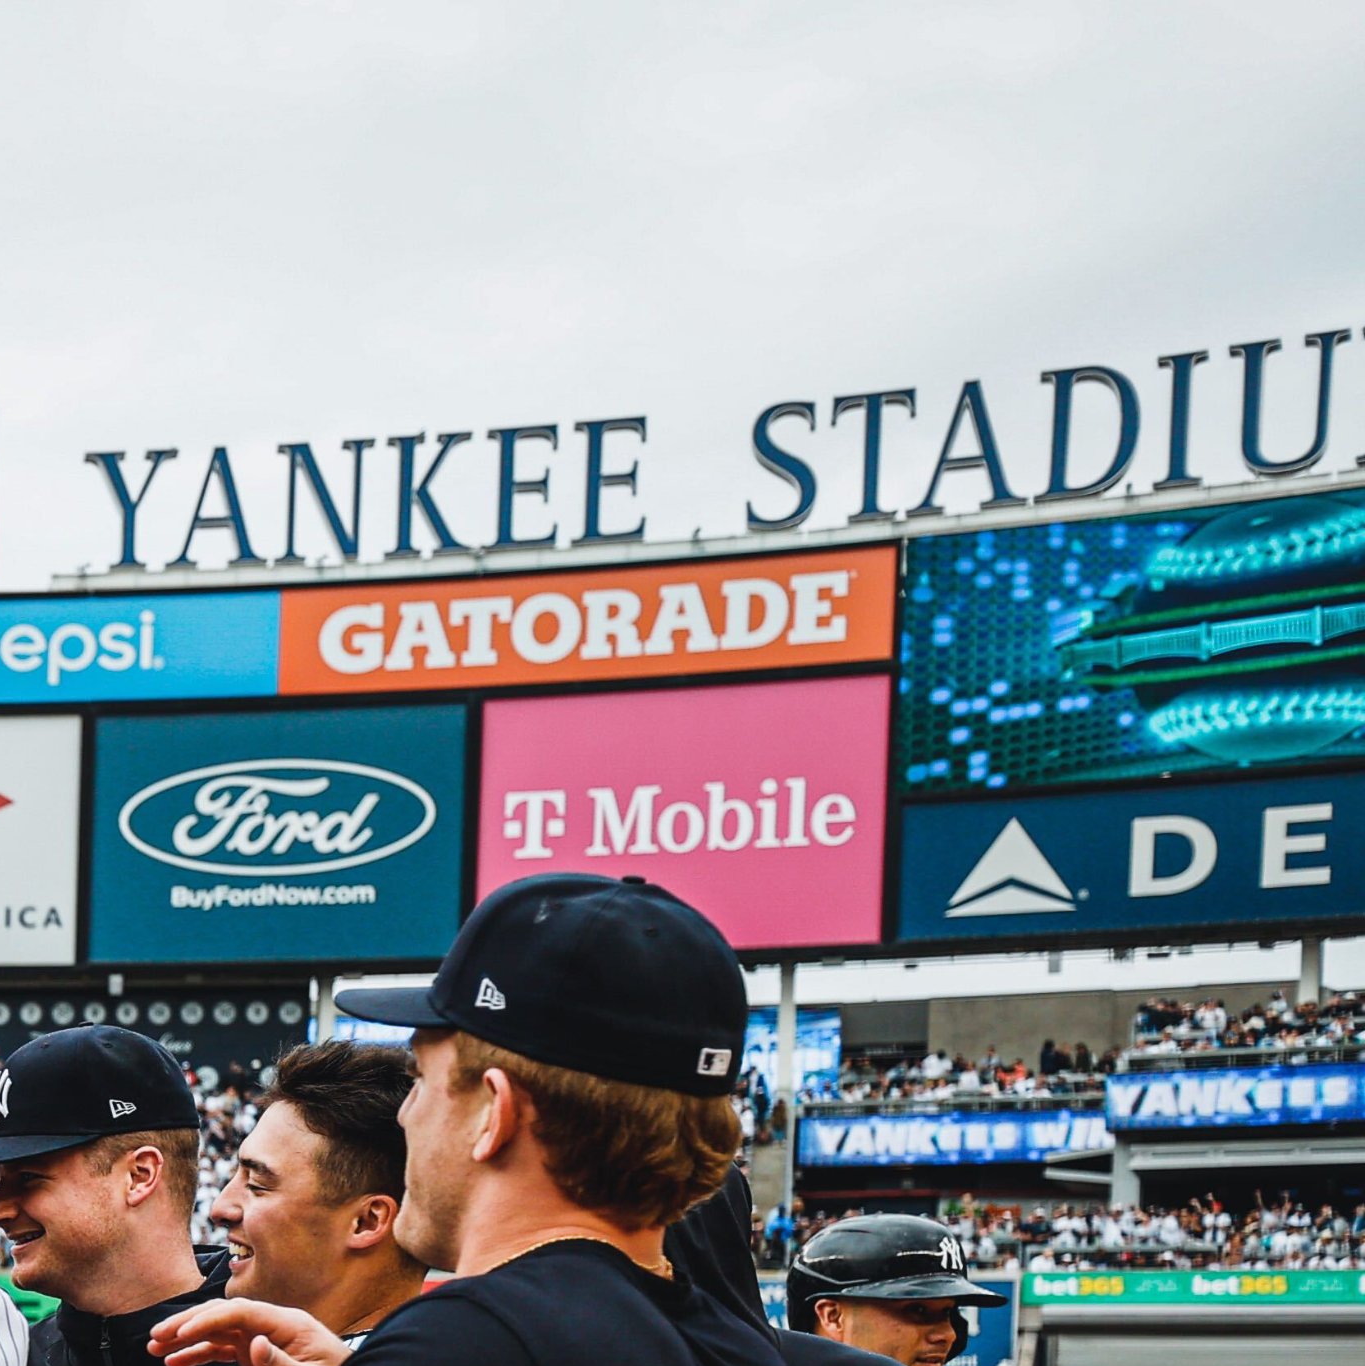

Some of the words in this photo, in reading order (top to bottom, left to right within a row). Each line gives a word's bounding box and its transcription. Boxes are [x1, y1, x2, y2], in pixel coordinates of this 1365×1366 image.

[85, 416, 647, 568] YANKEE
[746, 327, 1365, 531] STADIU
[319, 571, 849, 674] GATORADE
[173, 775, 380, 857] Ford
[585, 777, 857, 857] Mobile
[170, 884, 376, 909] BuyFordNow.com
[1033, 1275, 1124, 1297] bet365
[1191, 1275, 1288, 1297] bet365
